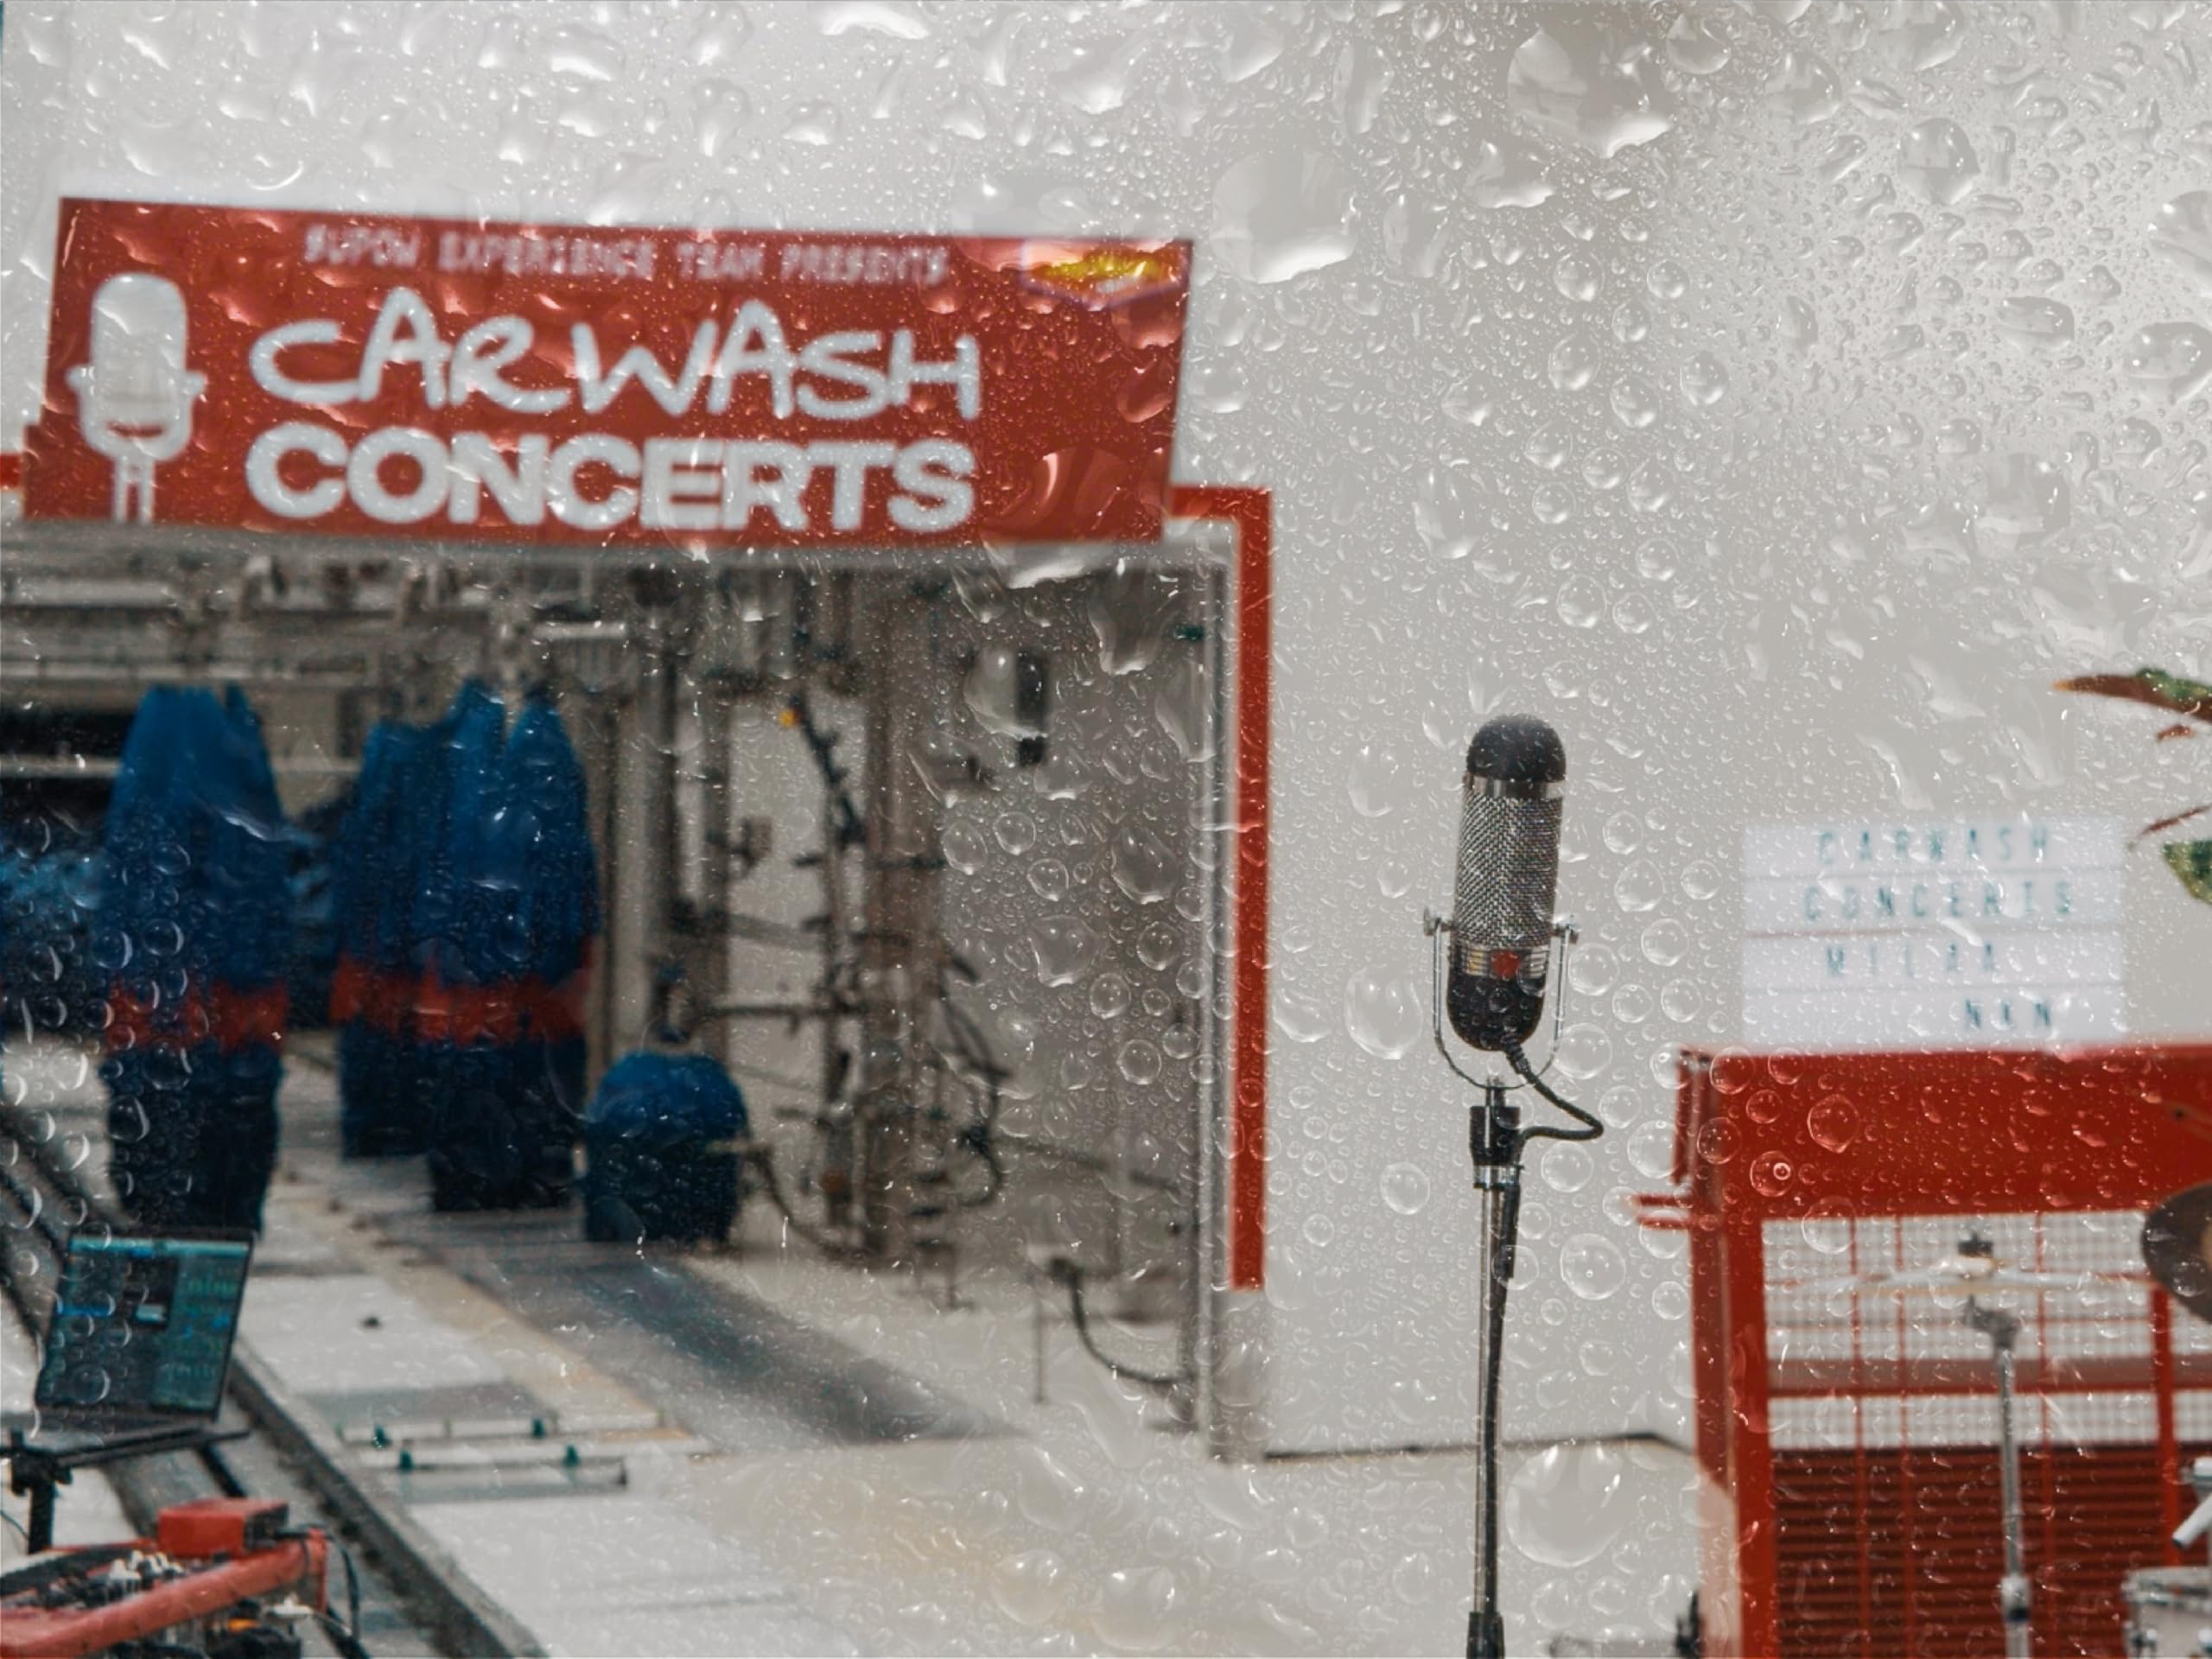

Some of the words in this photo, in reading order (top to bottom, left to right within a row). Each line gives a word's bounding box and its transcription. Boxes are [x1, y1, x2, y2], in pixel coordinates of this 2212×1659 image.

[677, 240, 765, 281] TEAM
[245, 420, 977, 532] CONCERTS
[1819, 826, 2048, 864] CARWASH
[1803, 880, 2073, 921] CONCERTS
